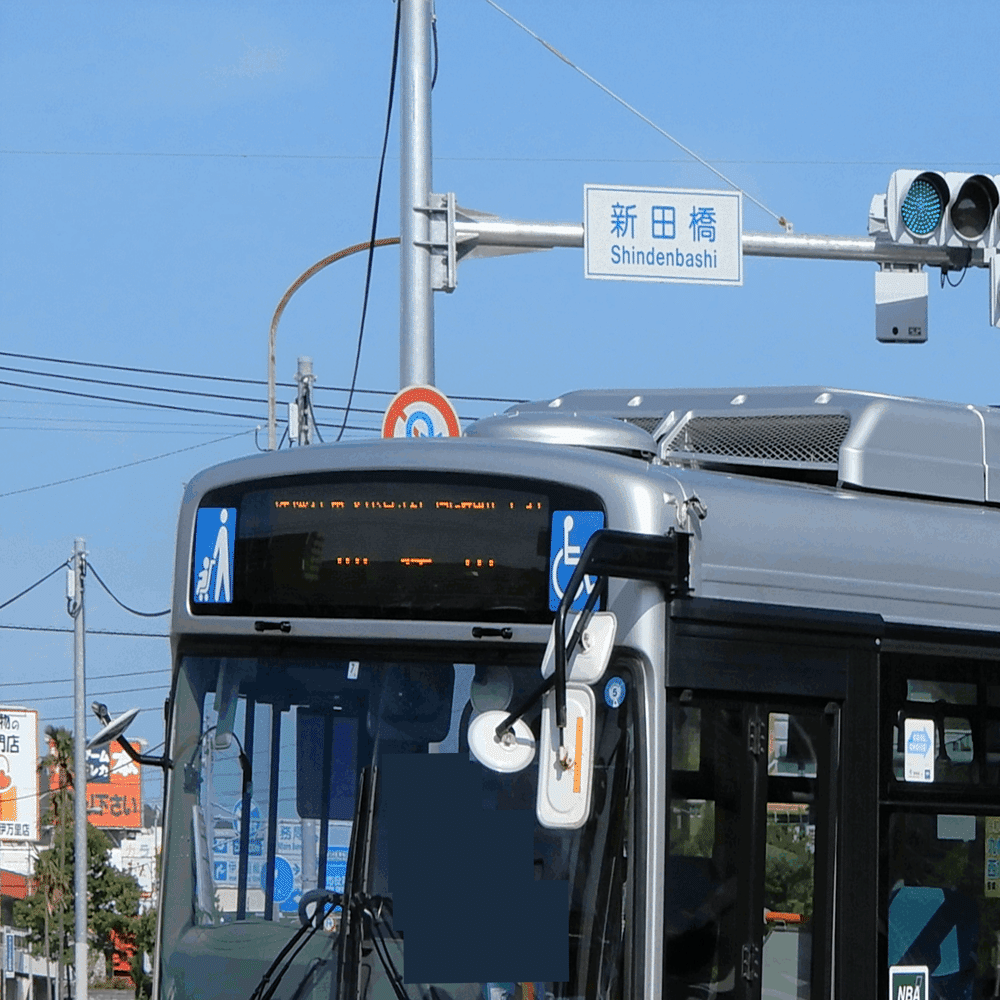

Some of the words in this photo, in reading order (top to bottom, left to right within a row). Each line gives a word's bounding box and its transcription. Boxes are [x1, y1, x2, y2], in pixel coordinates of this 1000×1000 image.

[611, 202, 717, 243] 新田橋
[611, 244, 717, 268] Shindenbashi
